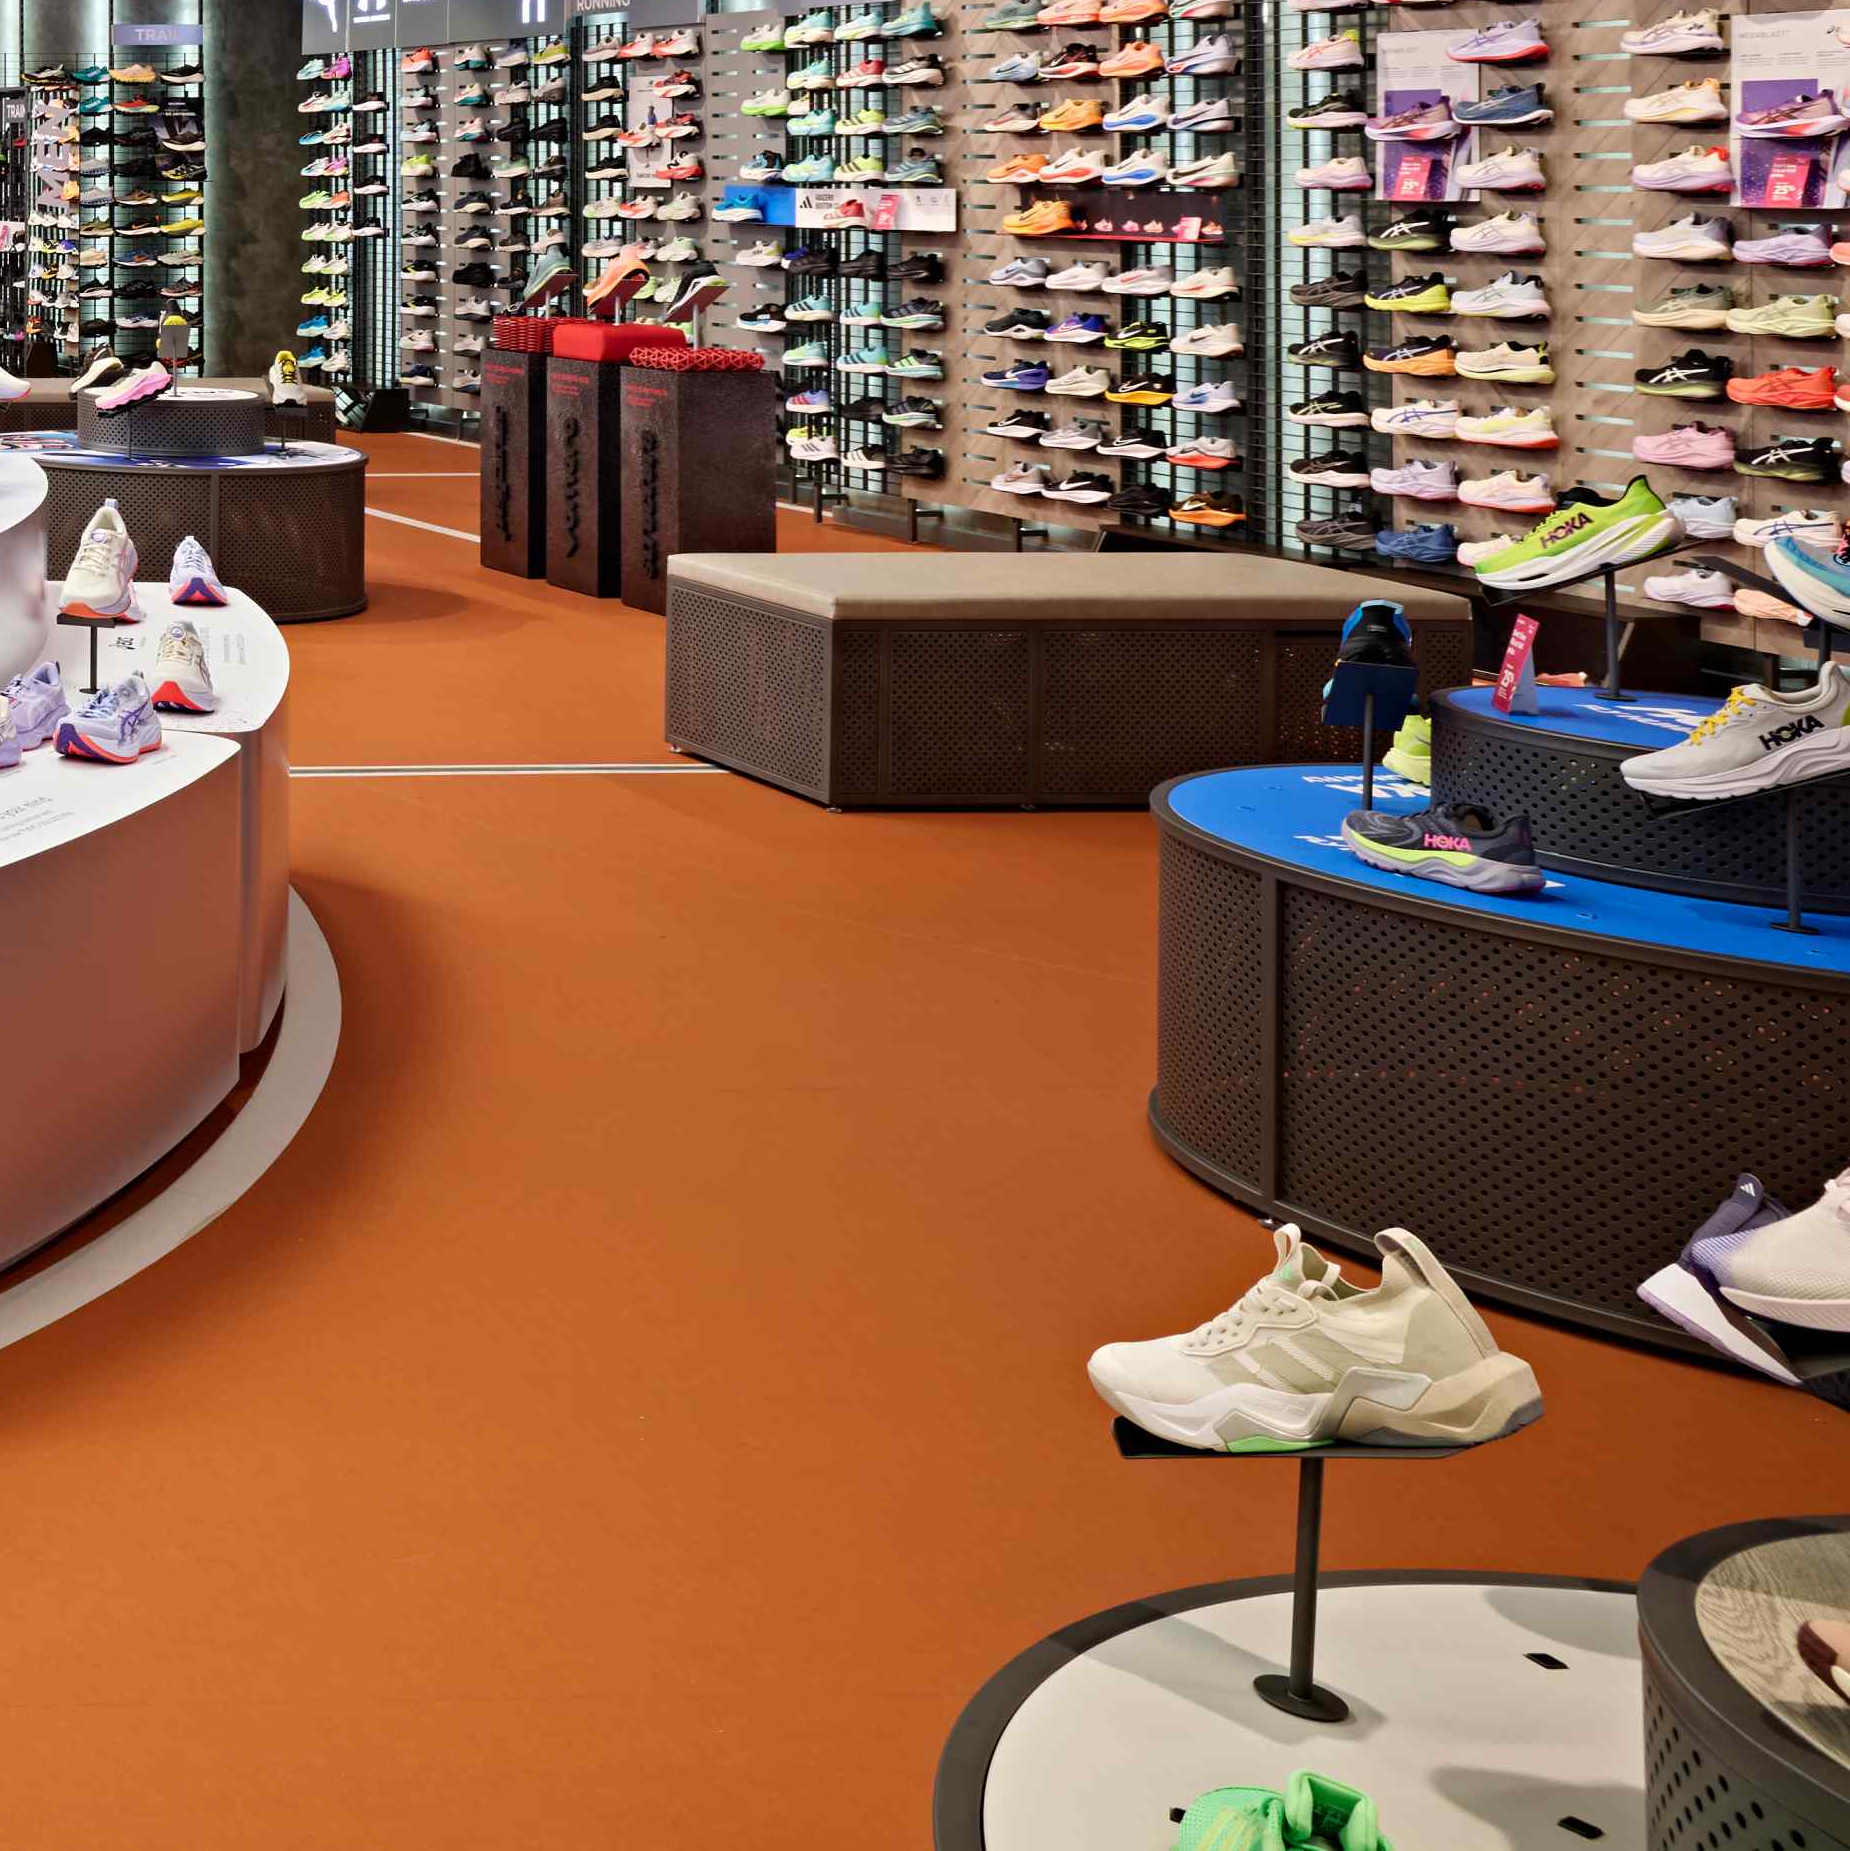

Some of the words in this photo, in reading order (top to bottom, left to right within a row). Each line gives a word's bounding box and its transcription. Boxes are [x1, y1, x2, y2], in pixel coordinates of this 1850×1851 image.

[1540, 511, 1595, 549] HOKA
[1758, 714, 1825, 751] HOKA
[1423, 832, 1472, 853] HOKA
